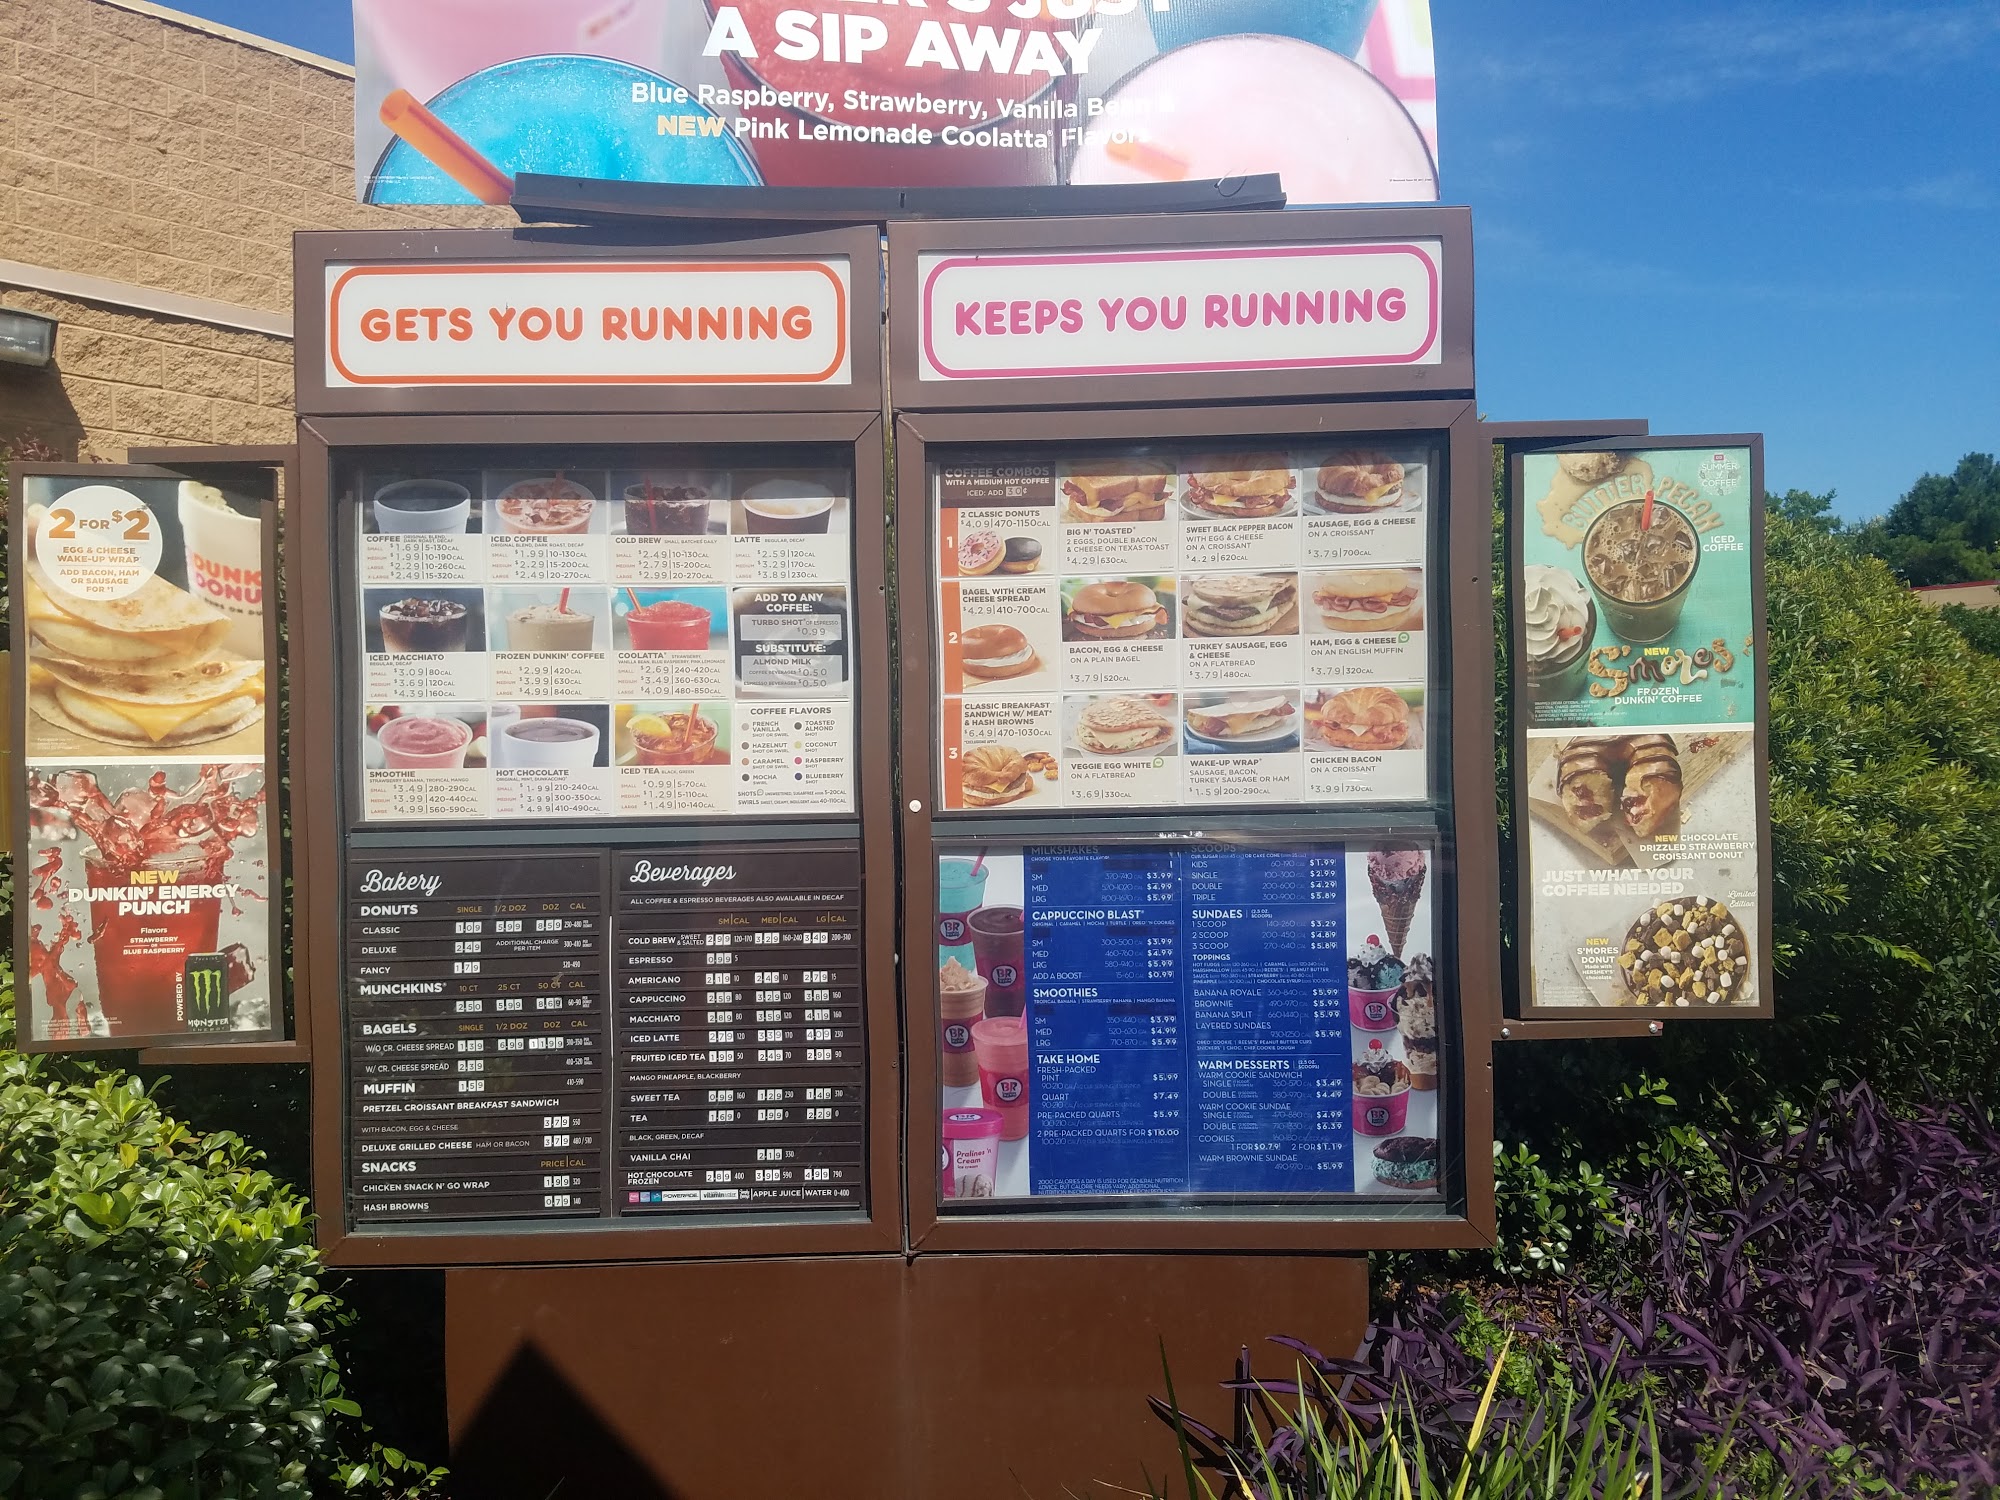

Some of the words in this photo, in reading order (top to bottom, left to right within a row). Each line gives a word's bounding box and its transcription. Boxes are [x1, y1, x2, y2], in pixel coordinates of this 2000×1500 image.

[702, 7, 758, 58] A
[774, 13, 889, 66] SIP
[905, 22, 1104, 78] AWAY
[631, 82, 689, 105] Blue
[698, 84, 835, 114] Raspberry,
[842, 90, 988, 120] Strawberry,
[996, 98, 1079, 119] Vanilla
[657, 116, 724, 138] NEW
[734, 118, 790, 140] Pink
[798, 120, 932, 146] Lemonade
[955, 299, 1083, 336] KEEPS
[1099, 296, 1187, 332] YOU
[1204, 287, 1407, 329] RUNNING
[359, 307, 474, 342] GETS
[489, 306, 583, 342] YOU
[603, 305, 813, 341] RUNNING
[1702, 463, 1737, 471] SUMMER
[945, 468, 993, 478] COFFEE
[996, 467, 1049, 477] COMBOS
[1653, 476, 1724, 534] PECAN
[49, 509, 75, 538] 2
[79, 520, 109, 529] FOR
[112, 510, 150, 540] $2
[947, 537, 952, 548] 1
[1703, 543, 1744, 551] COFFEE
[57, 555, 105, 563] WAKE-UP
[82, 569, 116, 577] BACON,
[755, 594, 779, 602] ADD
[800, 594, 824, 602] ANY
[766, 604, 813, 612] COFFEE:
[949, 632, 957, 643] 2
[756, 644, 826, 652] SUBSTITUTE:
[1069, 646, 1101, 655] BACON,
[1644, 648, 1669, 656] NEW
[571, 652, 604, 660] COFFEE
[1637, 687, 1679, 696] FROZEN
[1662, 694, 1702, 703] COFFEE
[949, 748, 957, 759] 3
[1071, 762, 1102, 770] VEGGIE
[1104, 762, 1121, 770] EGG
[1655, 834, 1678, 842] NEW
[1680, 833, 1738, 841] CHOCOLATE
[1640, 843, 1686, 851] DRIZZLED
[1689, 842, 1755, 850] STRAWBERRY
[1653, 852, 1706, 861] CROISSANT
[130, 870, 179, 884] NEW
[630, 860, 736, 887] Beverages
[1542, 870, 1585, 883] JUST
[1589, 869, 1646, 882] WHAT
[1648, 868, 1694, 880] YOUR
[360, 869, 442, 897] Bakery
[159, 884, 239, 900] ENERGY
[1542, 883, 1610, 897] COFFEE
[1613, 882, 1684, 895] NEEDED
[1728, 890, 1757, 899] Limited
[118, 901, 190, 916] PUNCH
[1729, 900, 1755, 908] Edition
[361, 905, 418, 916] DONUTS
[1192, 910, 1242, 918] SUNDAES
[1586, 938, 1609, 946] NEW
[362, 946, 397, 954] DELUXE
[629, 956, 673, 964] ESPRESSO
[1581, 956, 1615, 964] DONUT
[176, 972, 182, 982] BY
[628, 976, 680, 984] AMERICANO
[1033, 988, 1098, 997] SMOOTHIES
[630, 995, 686, 1004] CAPPUCCINO
[188, 1018, 229, 1026] MONSTER
[630, 1015, 680, 1023] MACCHIATO
[363, 1024, 416, 1034] BAGELS
[1037, 1055, 1063, 1064] TAKE
[1066, 1055, 1100, 1063] HOME
[1198, 1061, 1232, 1069] WARM
[1235, 1060, 1289, 1069] DESSERTS
[364, 1083, 415, 1094] MUFFIN
[630, 1094, 661, 1102] SWEET
[957, 1150, 984, 1158] Pralines
[362, 1162, 416, 1172] SNACKS
[363, 1203, 388, 1211] HASH
